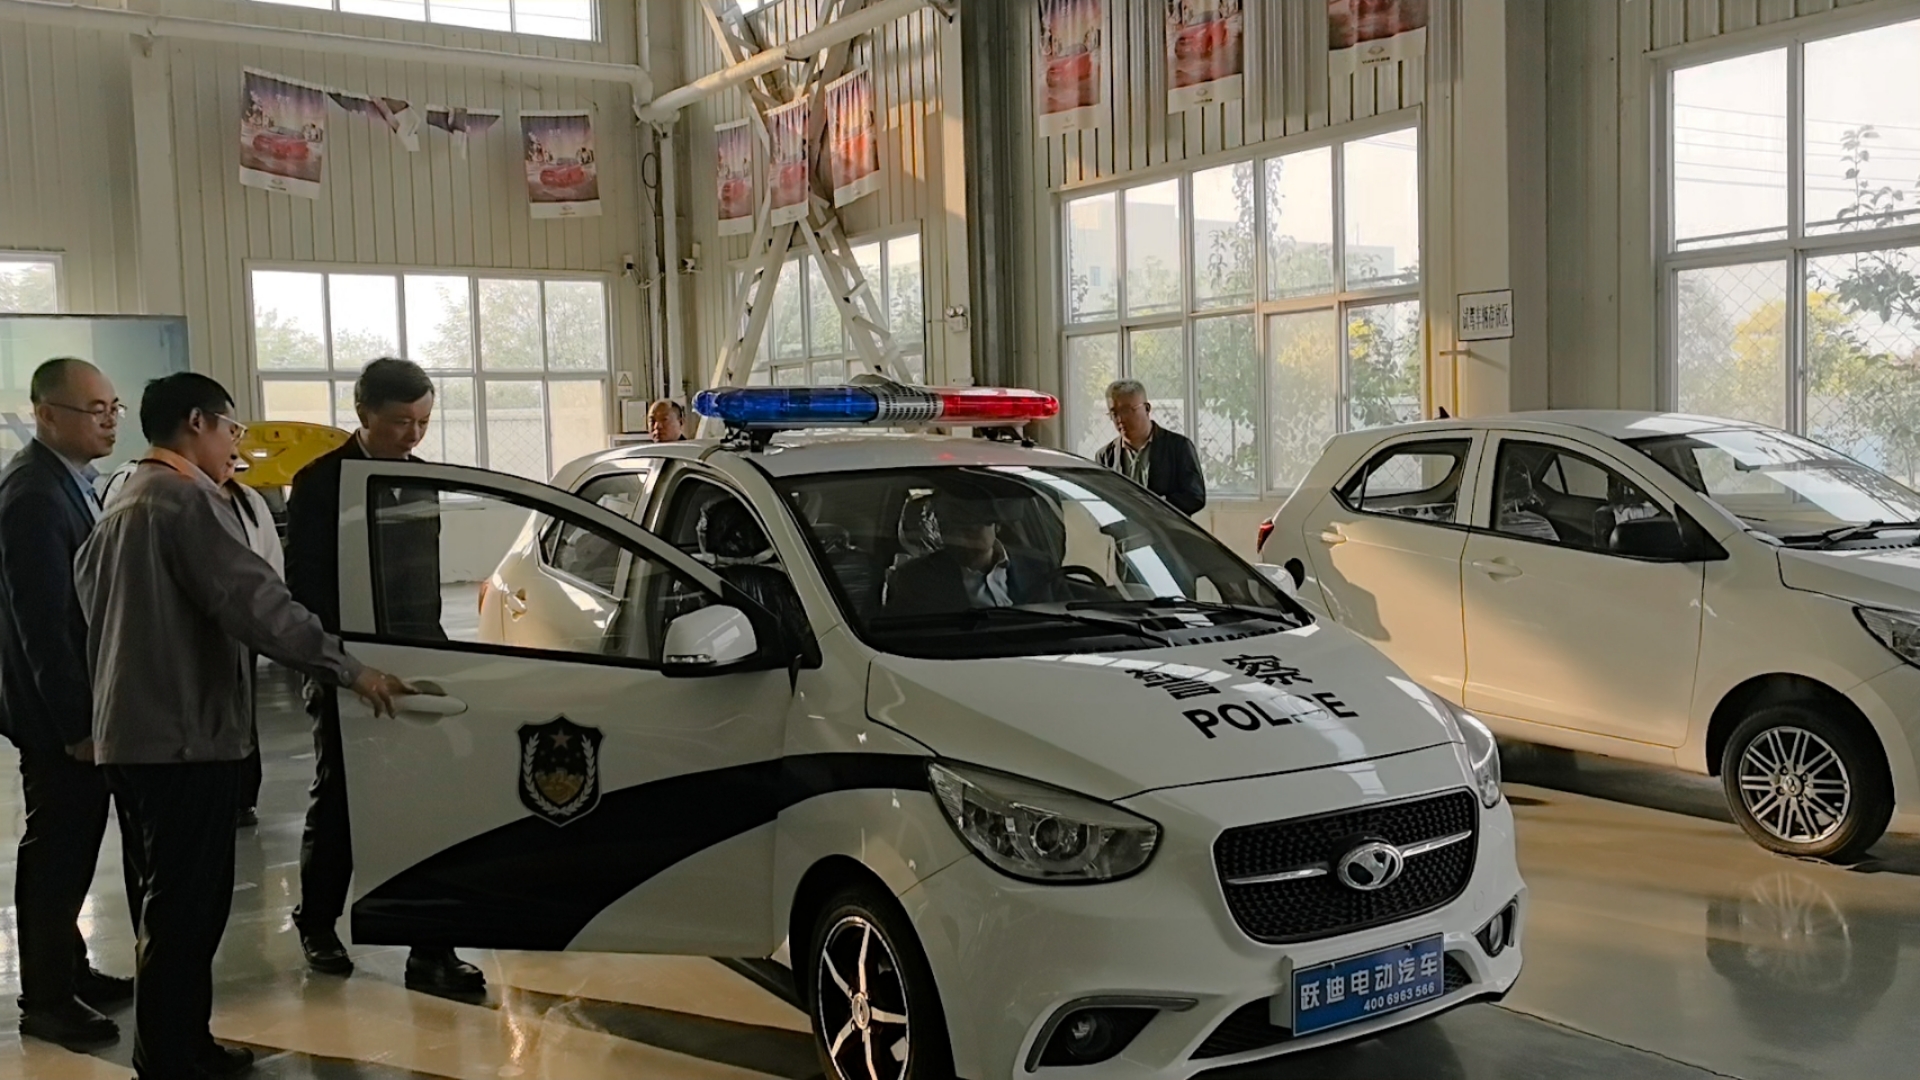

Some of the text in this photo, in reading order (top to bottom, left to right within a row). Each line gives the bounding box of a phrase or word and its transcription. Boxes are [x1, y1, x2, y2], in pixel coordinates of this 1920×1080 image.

[1300, 951, 1437, 1011] 跃迪电动汽车
[1363, 981, 1436, 1012] 400 6963 566
